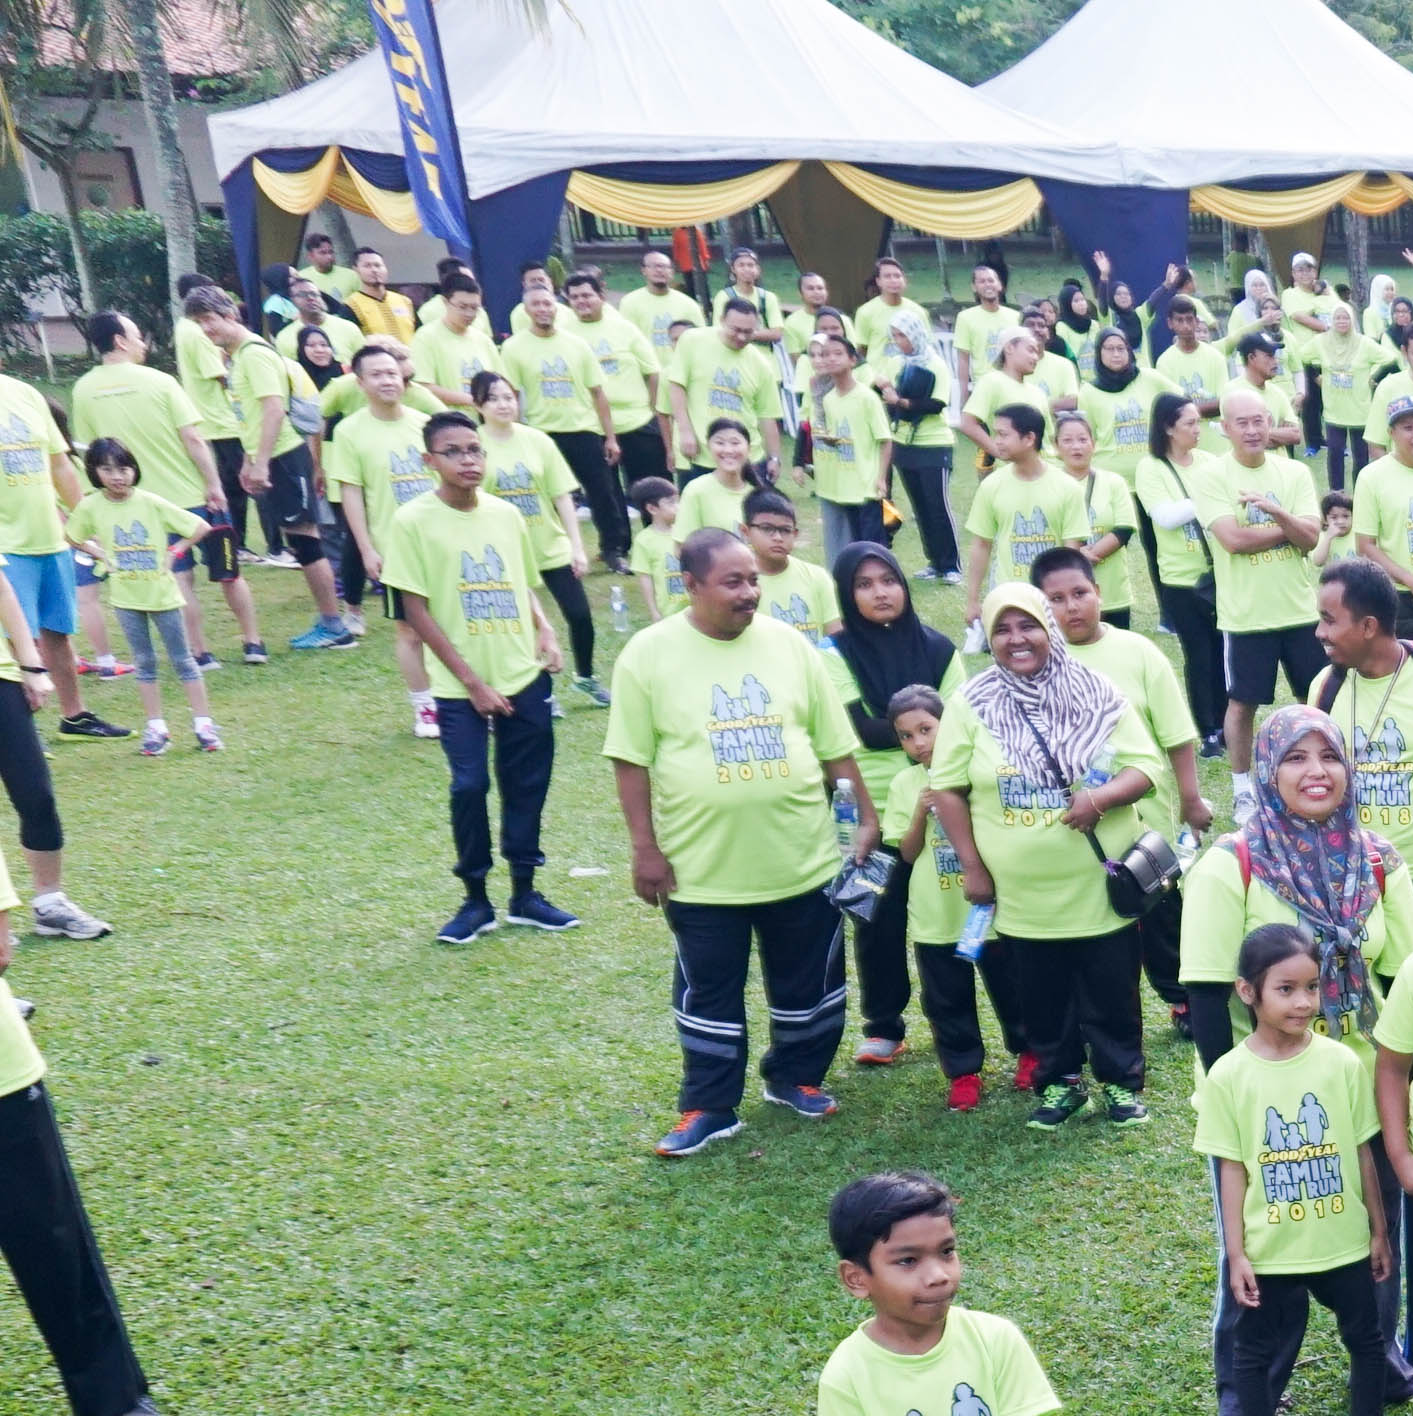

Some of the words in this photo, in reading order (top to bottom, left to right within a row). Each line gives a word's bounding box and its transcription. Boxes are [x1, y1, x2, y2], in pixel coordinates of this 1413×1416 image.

[706, 714, 784, 731] GOODYEAR
[709, 726, 786, 753] FAMILY
[713, 746, 750, 767] FUN
[752, 743, 788, 762] RUN
[716, 761, 790, 784] 2018
[1000, 791, 1034, 810] FUN
[1375, 788, 1412, 807] RUN
[1358, 807, 1412, 826] 018
[1257, 1143, 1339, 1165] GOODYEAR
[1260, 1155, 1341, 1187] FAMILY
[1264, 1182, 1304, 1204] FUN
[1306, 1175, 1344, 1200] RUN
[1267, 1195, 1345, 1225] 2018
